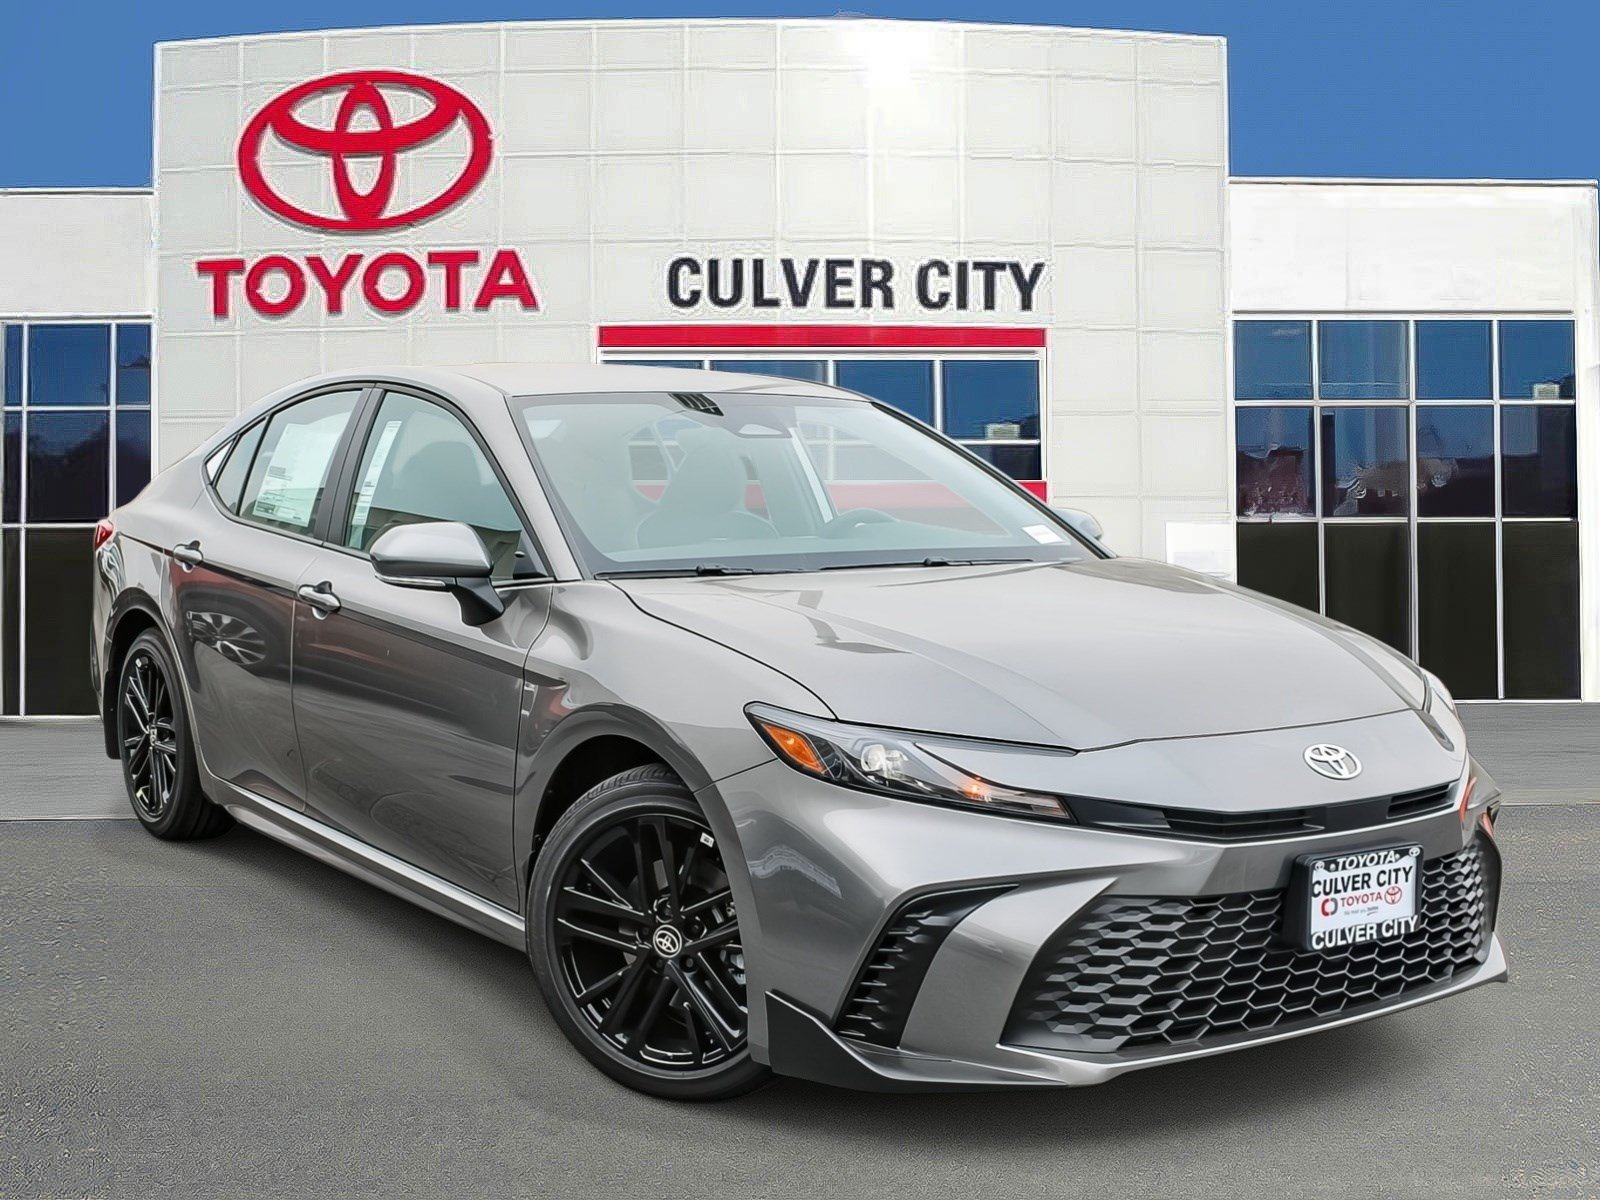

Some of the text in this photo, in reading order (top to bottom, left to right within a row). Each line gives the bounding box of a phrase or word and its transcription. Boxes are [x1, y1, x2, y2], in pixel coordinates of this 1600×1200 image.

[195, 250, 540, 318] TOYOTA
[666, 257, 1045, 311] CULVER CITY
[1336, 850, 1396, 871] TOYOTA
[1312, 866, 1413, 898] CULVER CITY
[1341, 891, 1383, 907] TOYOTA
[1311, 915, 1418, 950] CULVER CITY
